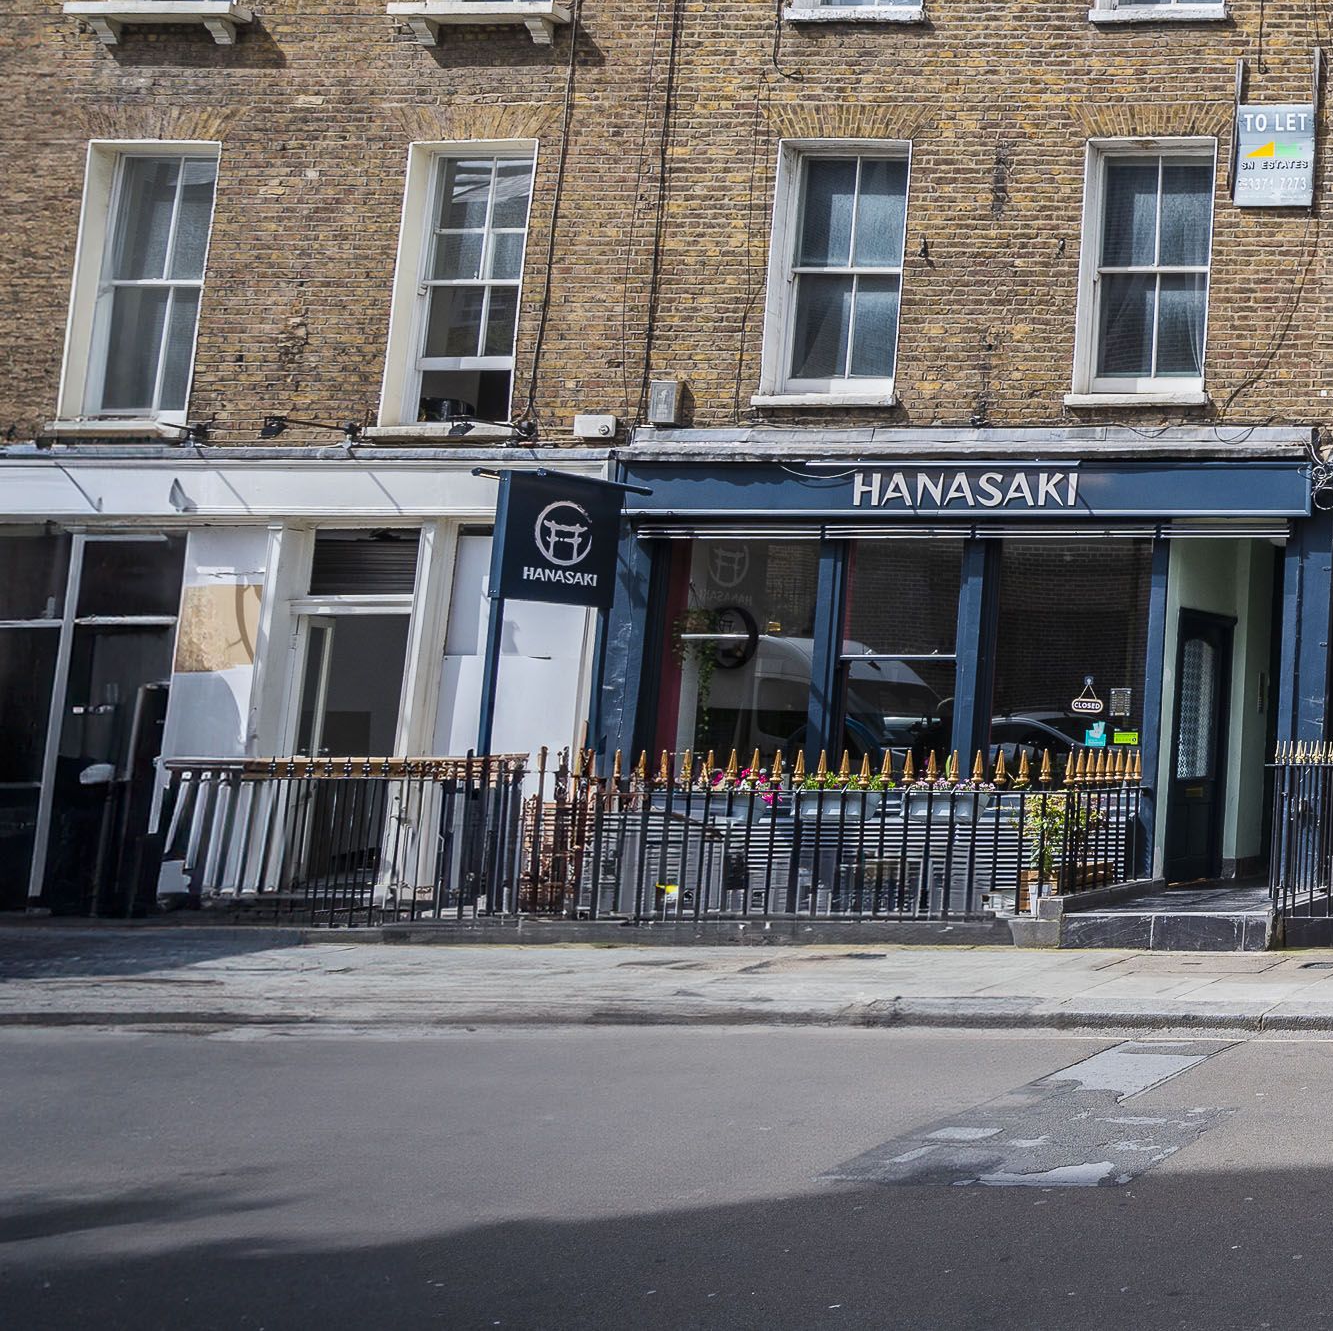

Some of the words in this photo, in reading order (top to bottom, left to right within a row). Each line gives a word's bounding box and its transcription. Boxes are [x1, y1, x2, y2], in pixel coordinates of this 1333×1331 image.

[1243, 113, 1267, 132] TO
[1275, 113, 1308, 132] LET
[1261, 160, 1309, 170] ESTATES
[1280, 177, 1307, 191] 7273
[853, 472, 1079, 507] HANASAKI
[522, 566, 598, 587] HANASAKI
